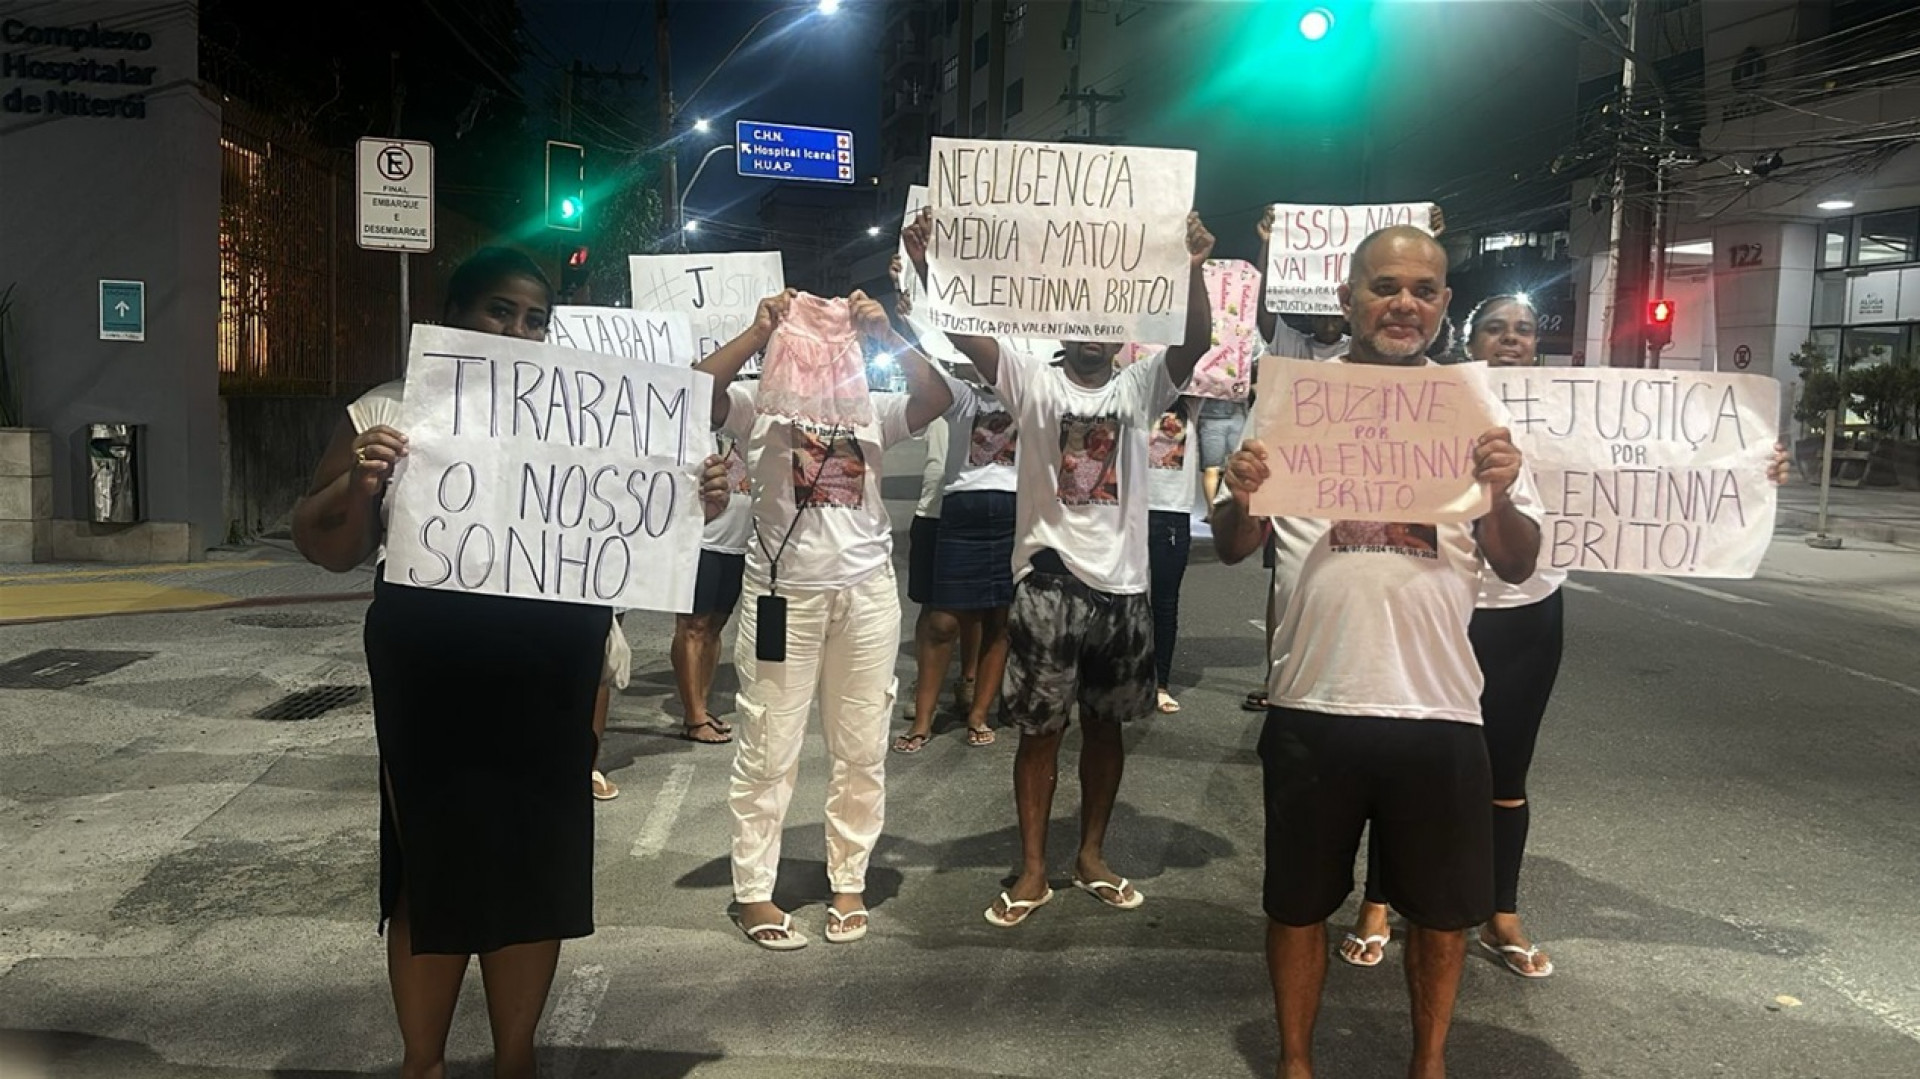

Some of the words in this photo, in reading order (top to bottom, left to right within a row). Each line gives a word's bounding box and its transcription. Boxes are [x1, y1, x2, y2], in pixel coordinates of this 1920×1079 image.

[2, 19, 152, 51] Complexo
[2, 53, 157, 85] Hospitalar
[3, 86, 42, 114] de
[45, 90, 147, 119] Niterói
[753, 144, 800, 158] Hospital
[372, 198, 420, 209] EMBARQUE
[382, 185, 408, 194] FINAL
[364, 224, 427, 237] DESEMBARQUE
[394, 213, 401, 222] E
[1284, 206, 1350, 250] ISSO
[935, 211, 1020, 263] MÉDICA
[1040, 218, 1146, 273] MATOU
[1729, 243, 1763, 268] 122
[1273, 256, 1307, 281] VAI
[1324, 252, 1348, 284] FIC
[931, 273, 1091, 313] VALENTINNA
[1104, 276, 1174, 317] BRITO!
[544, 314, 675, 364] ATARAM
[422, 352, 689, 467] TIRARAM
[1292, 378, 1457, 427] BUZINE
[1501, 376, 1746, 450] #JUSTIÇA
[1354, 426, 1389, 440] POR
[1610, 443, 1647, 464] POR
[438, 461, 478, 514] O
[519, 462, 677, 538] NOSSO
[1316, 477, 1416, 514] BRITO
[408, 516, 631, 600] SONHO
[1550, 519, 1702, 572] BRITO!
